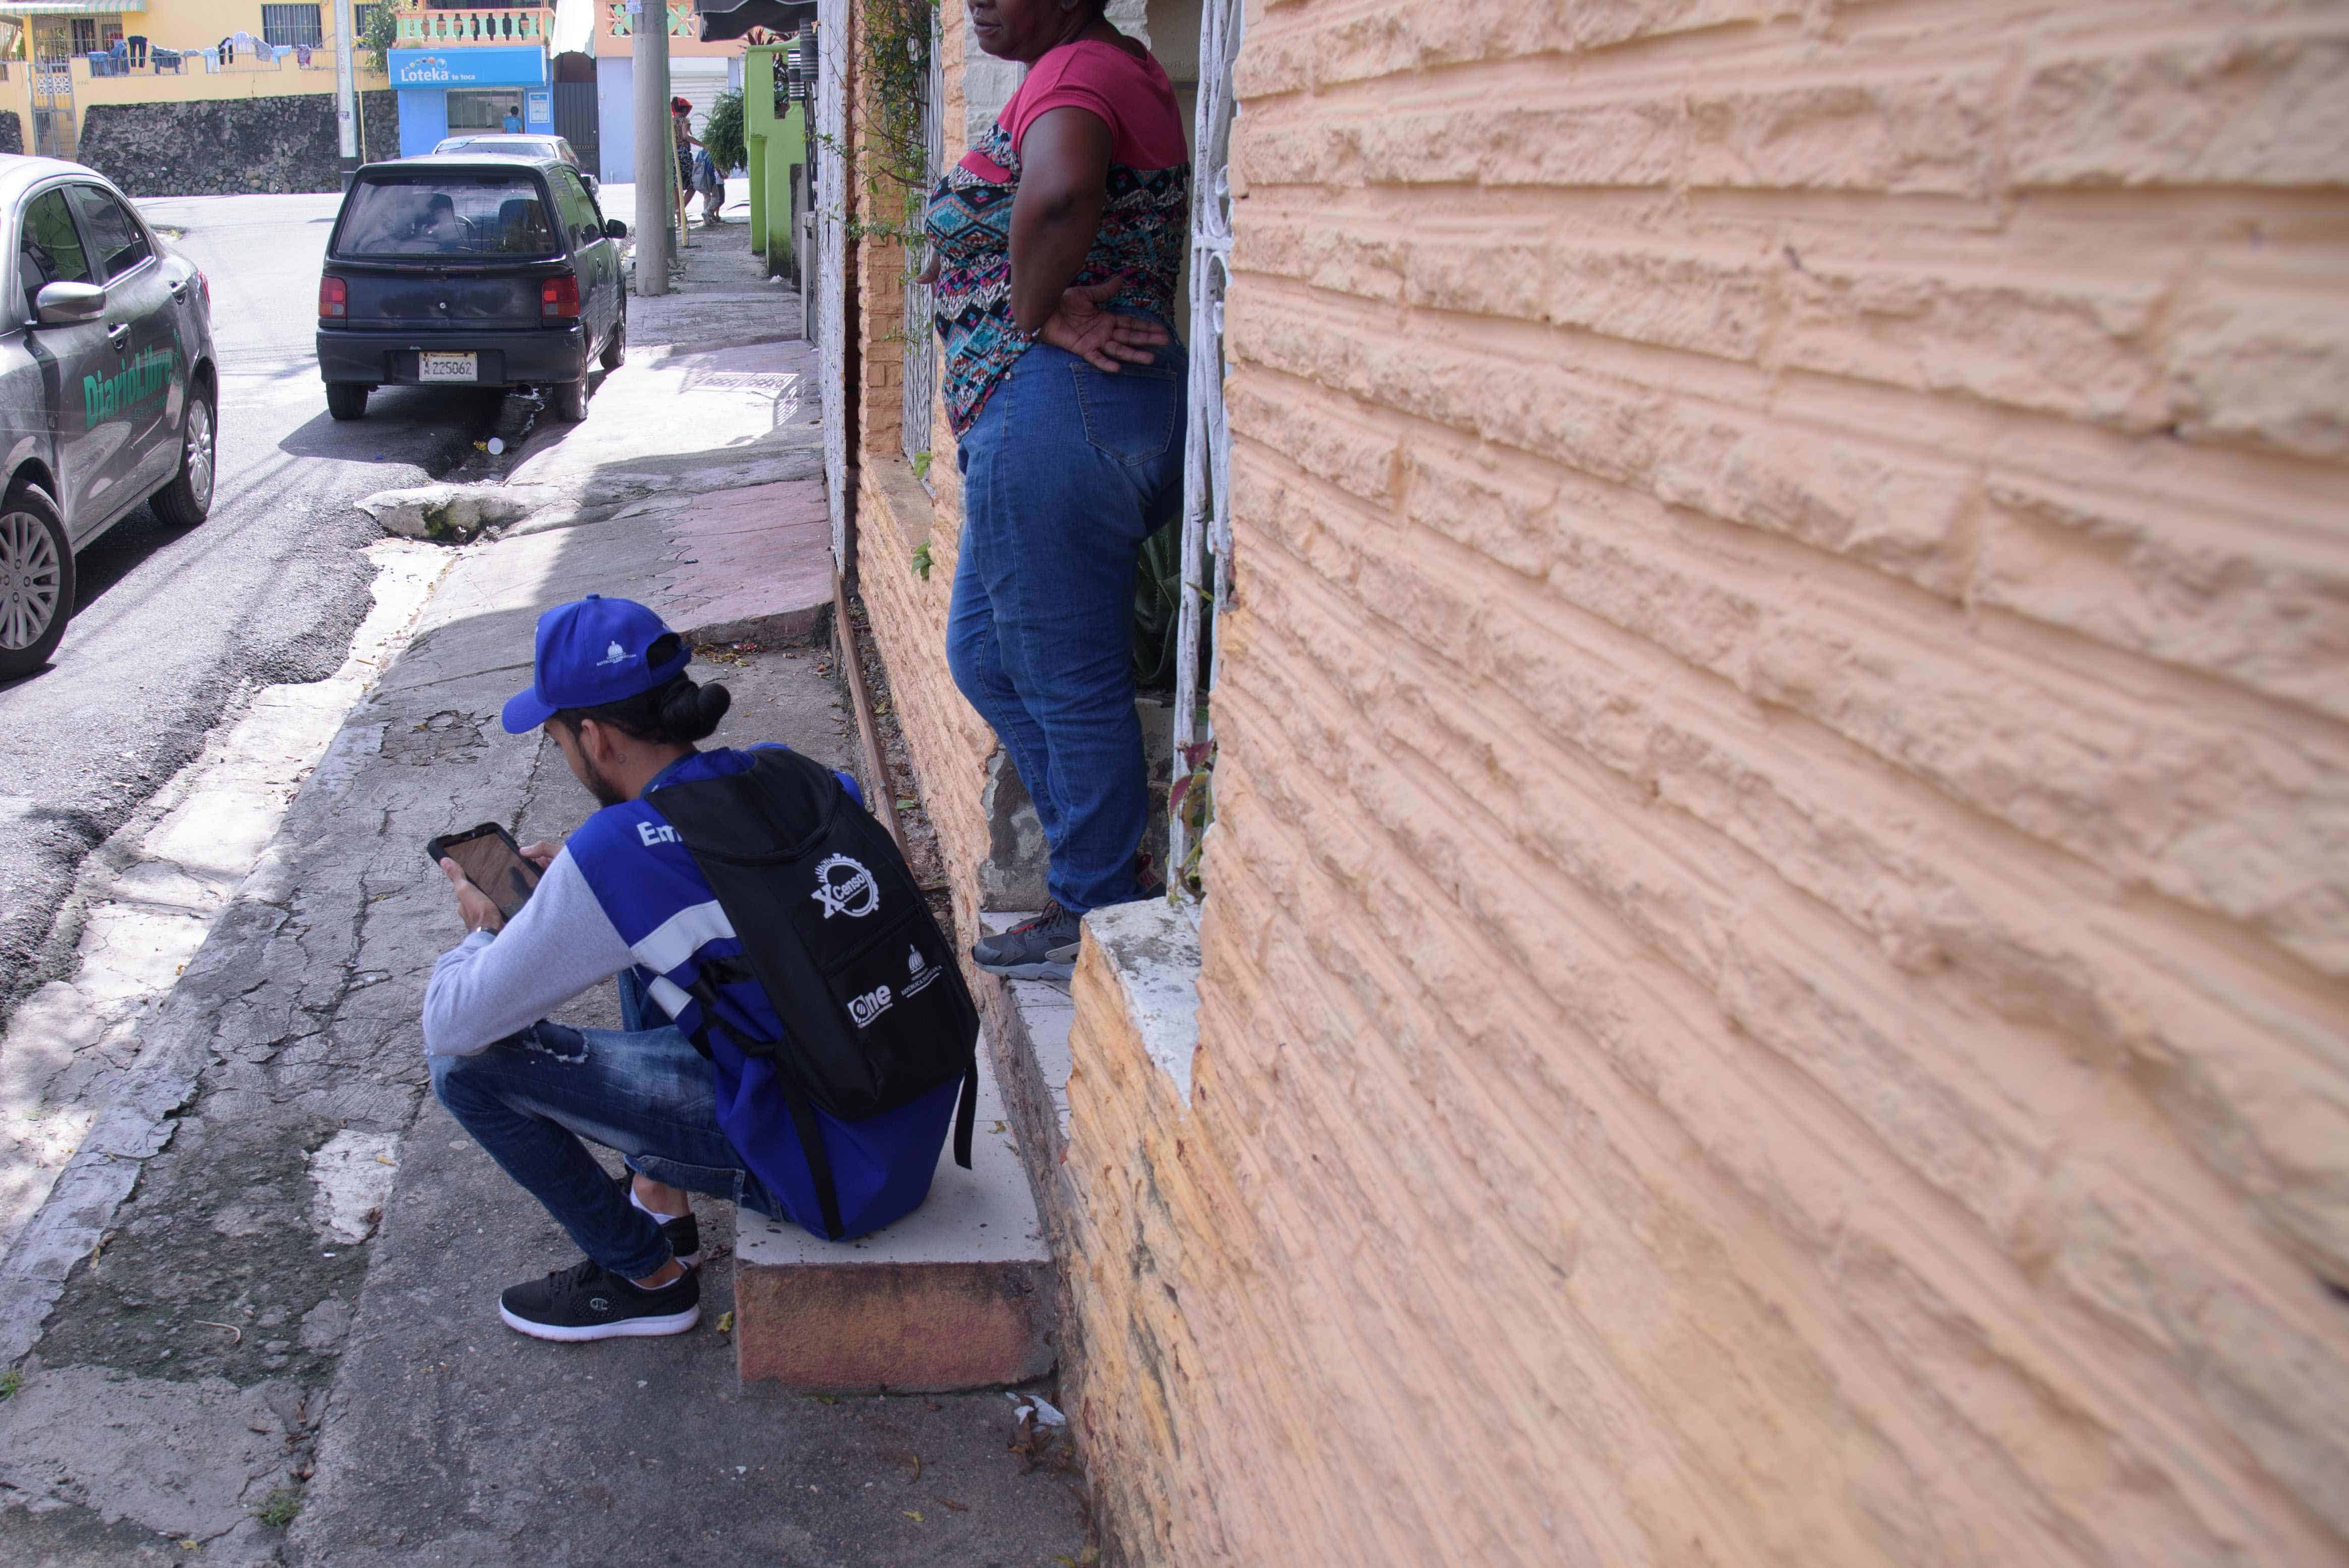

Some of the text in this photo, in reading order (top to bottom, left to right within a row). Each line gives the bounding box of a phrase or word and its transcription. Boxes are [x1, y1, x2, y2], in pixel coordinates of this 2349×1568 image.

[400, 67, 449, 82] Loteka
[833, 873, 866, 900] Censo
[847, 985, 892, 1023] One
